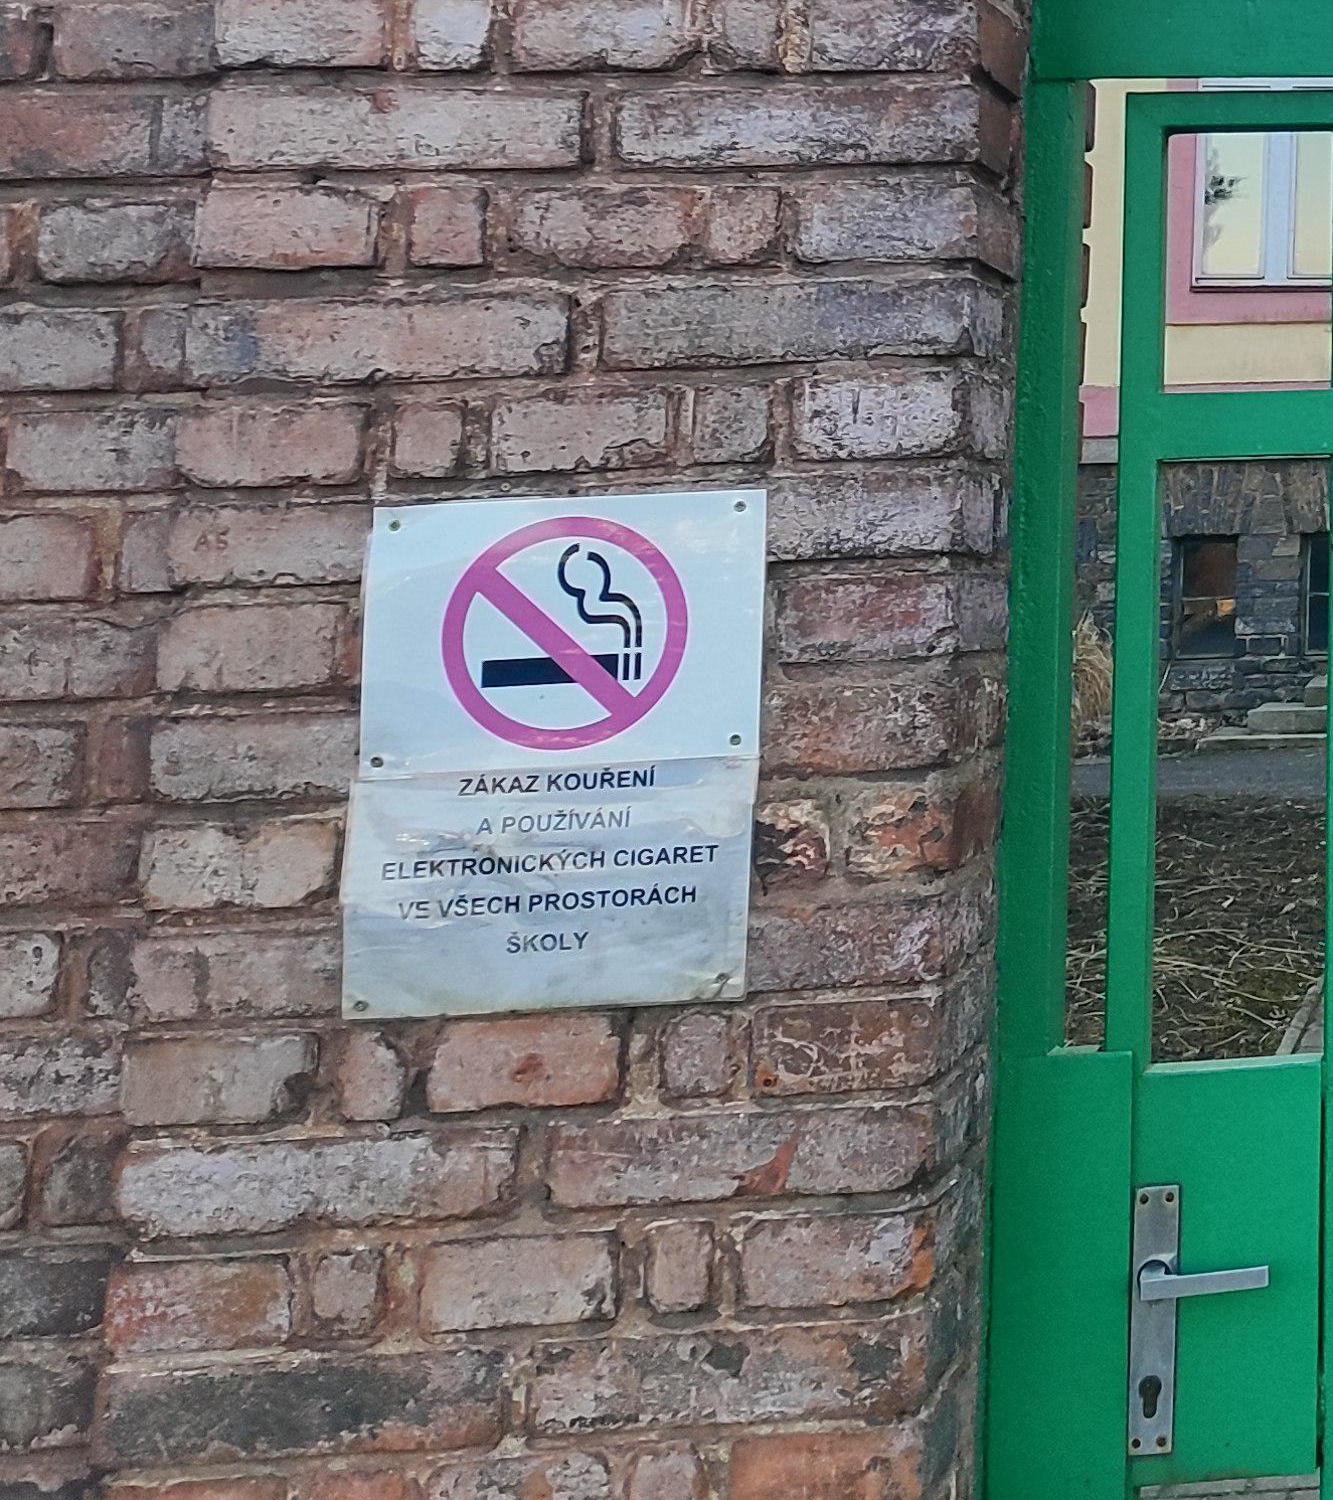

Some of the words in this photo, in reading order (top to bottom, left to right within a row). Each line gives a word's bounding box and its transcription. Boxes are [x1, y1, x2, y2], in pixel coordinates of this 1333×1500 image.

[458, 773, 540, 797] ZÁKAZ
[546, 764, 657, 792] KOUŘENÍ
[476, 817, 493, 835] A
[501, 806, 632, 834] POUŽÍVÁNÍ
[381, 849, 604, 881] ELEKTRONICKÝCH
[613, 844, 720, 866] CIGARET
[436, 894, 520, 918] VŠECH
[528, 884, 697, 912] PROSTORÁCH
[506, 931, 590, 954] ŠKOLY
